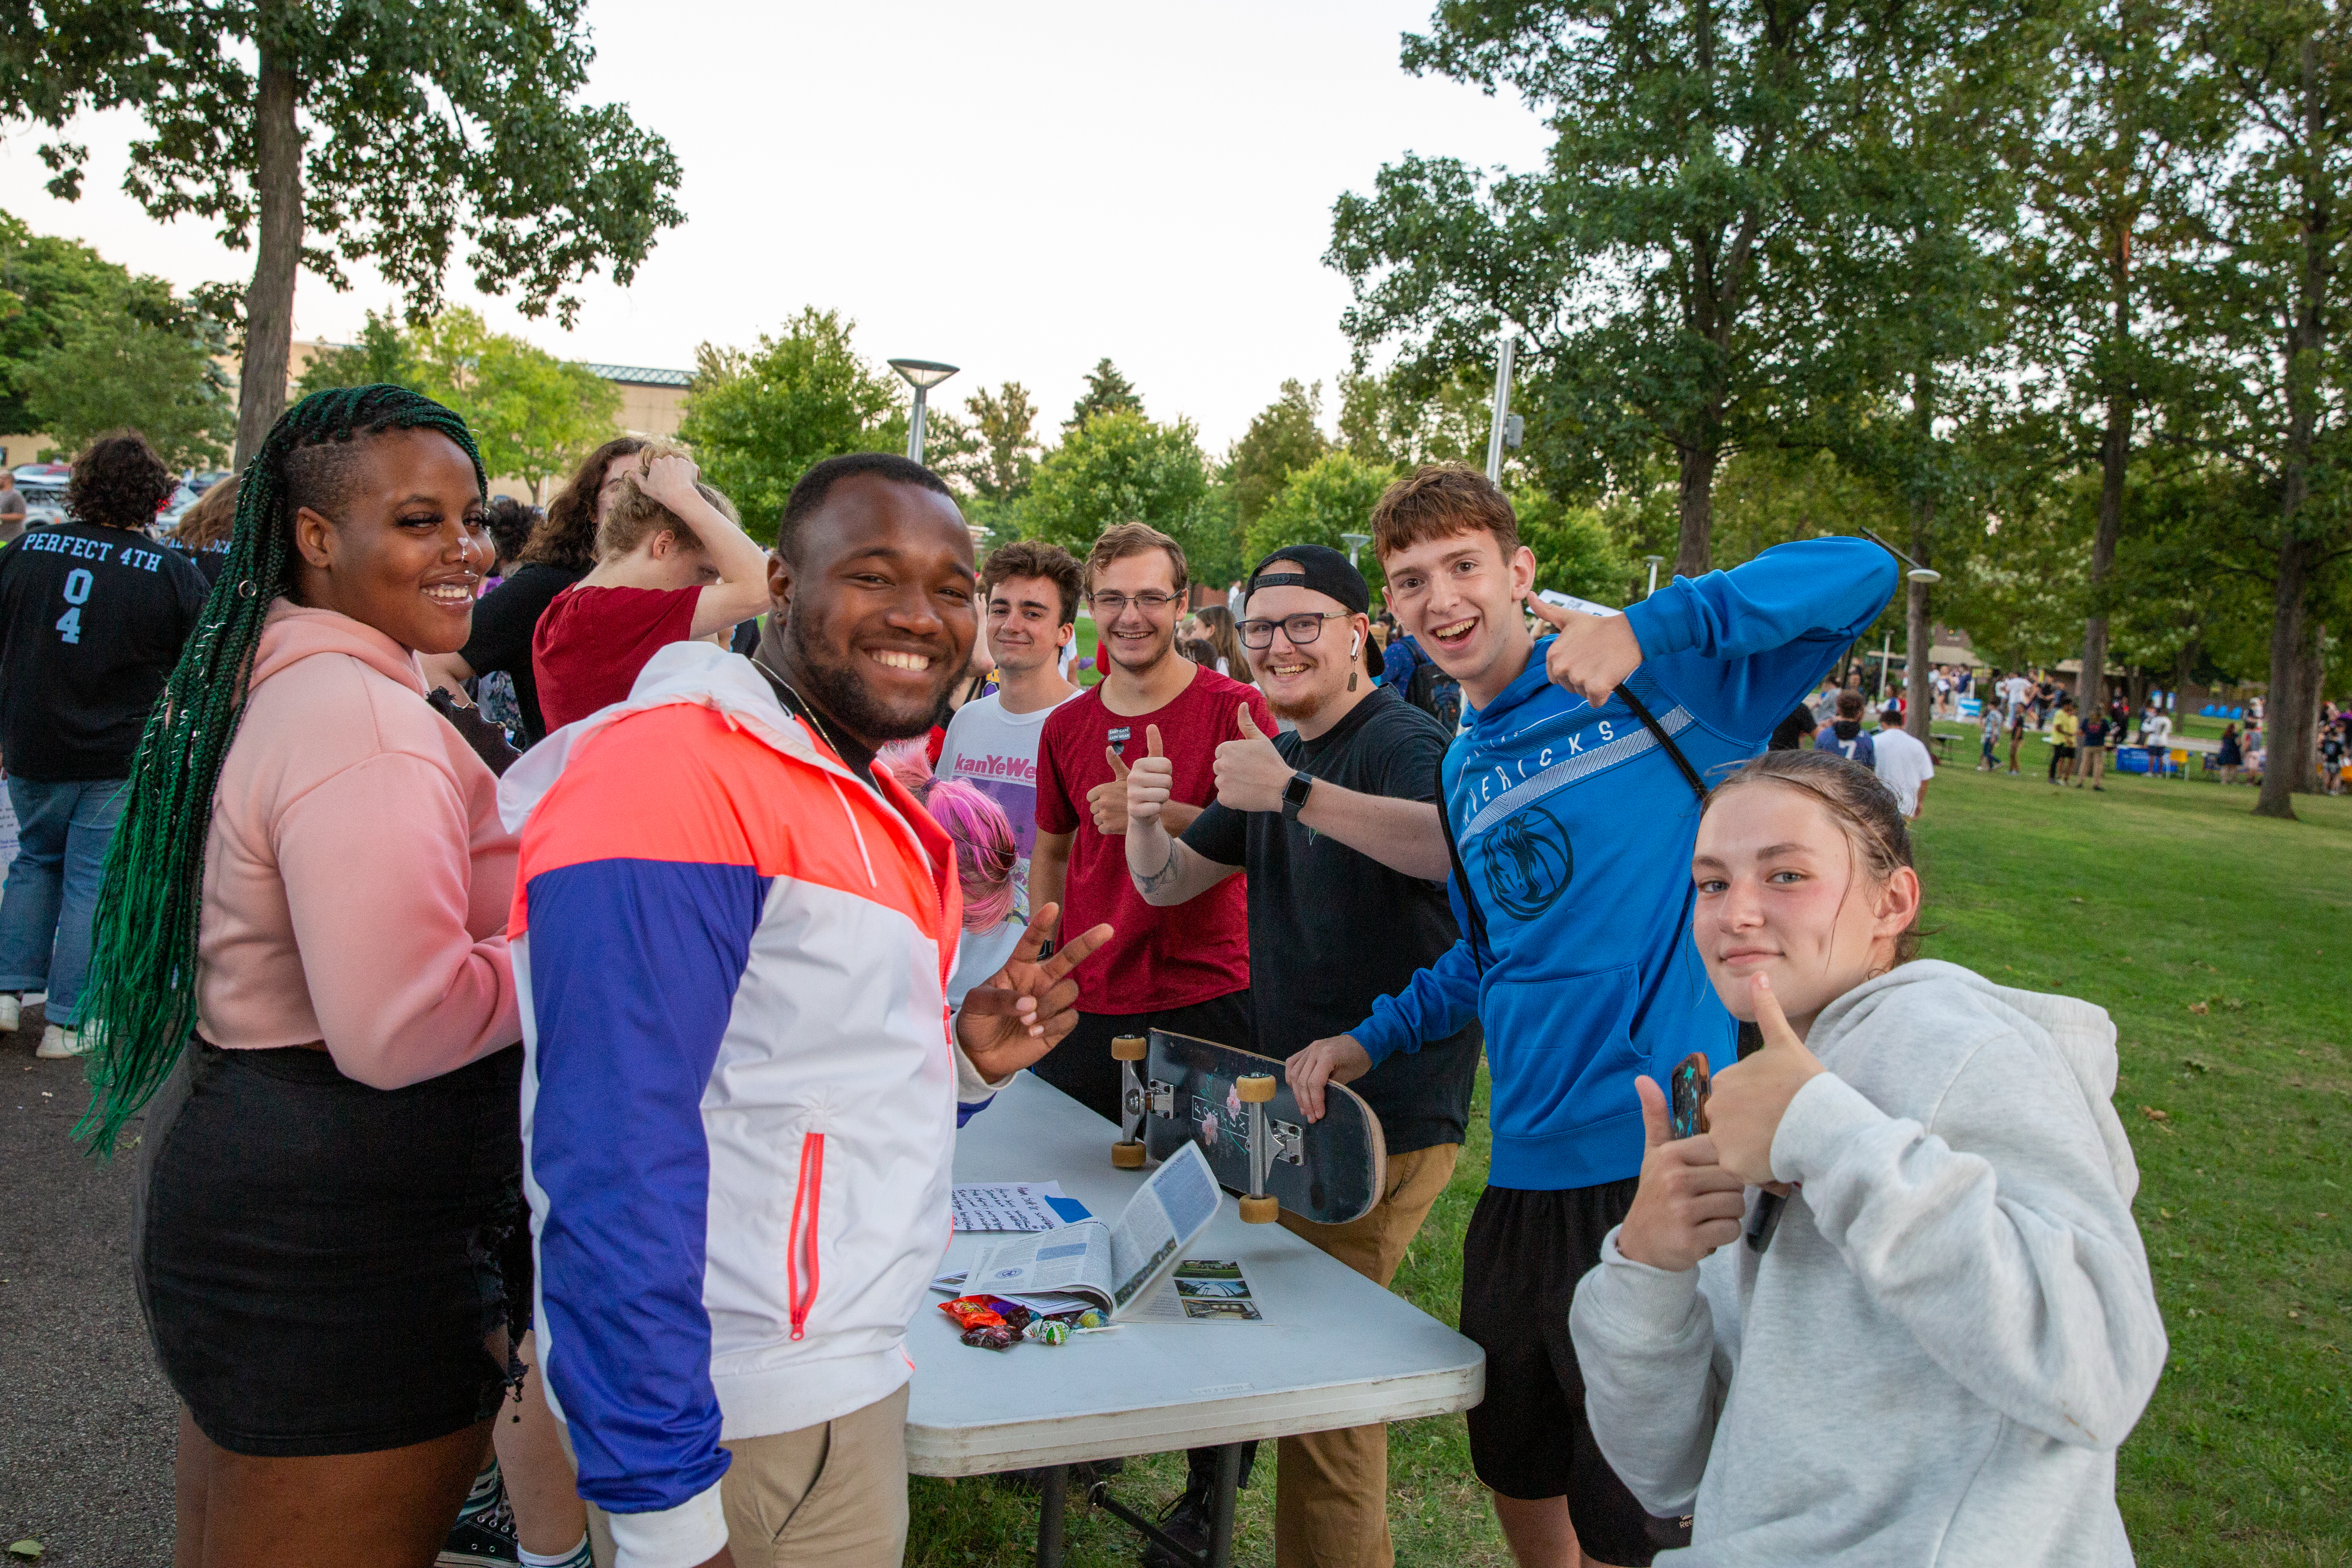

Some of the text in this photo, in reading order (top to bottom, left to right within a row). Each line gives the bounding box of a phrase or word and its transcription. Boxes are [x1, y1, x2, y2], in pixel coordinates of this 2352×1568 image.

[22, 533, 162, 572] PERFECT 4TH
[1463, 720, 1614, 826] AVERICKS
